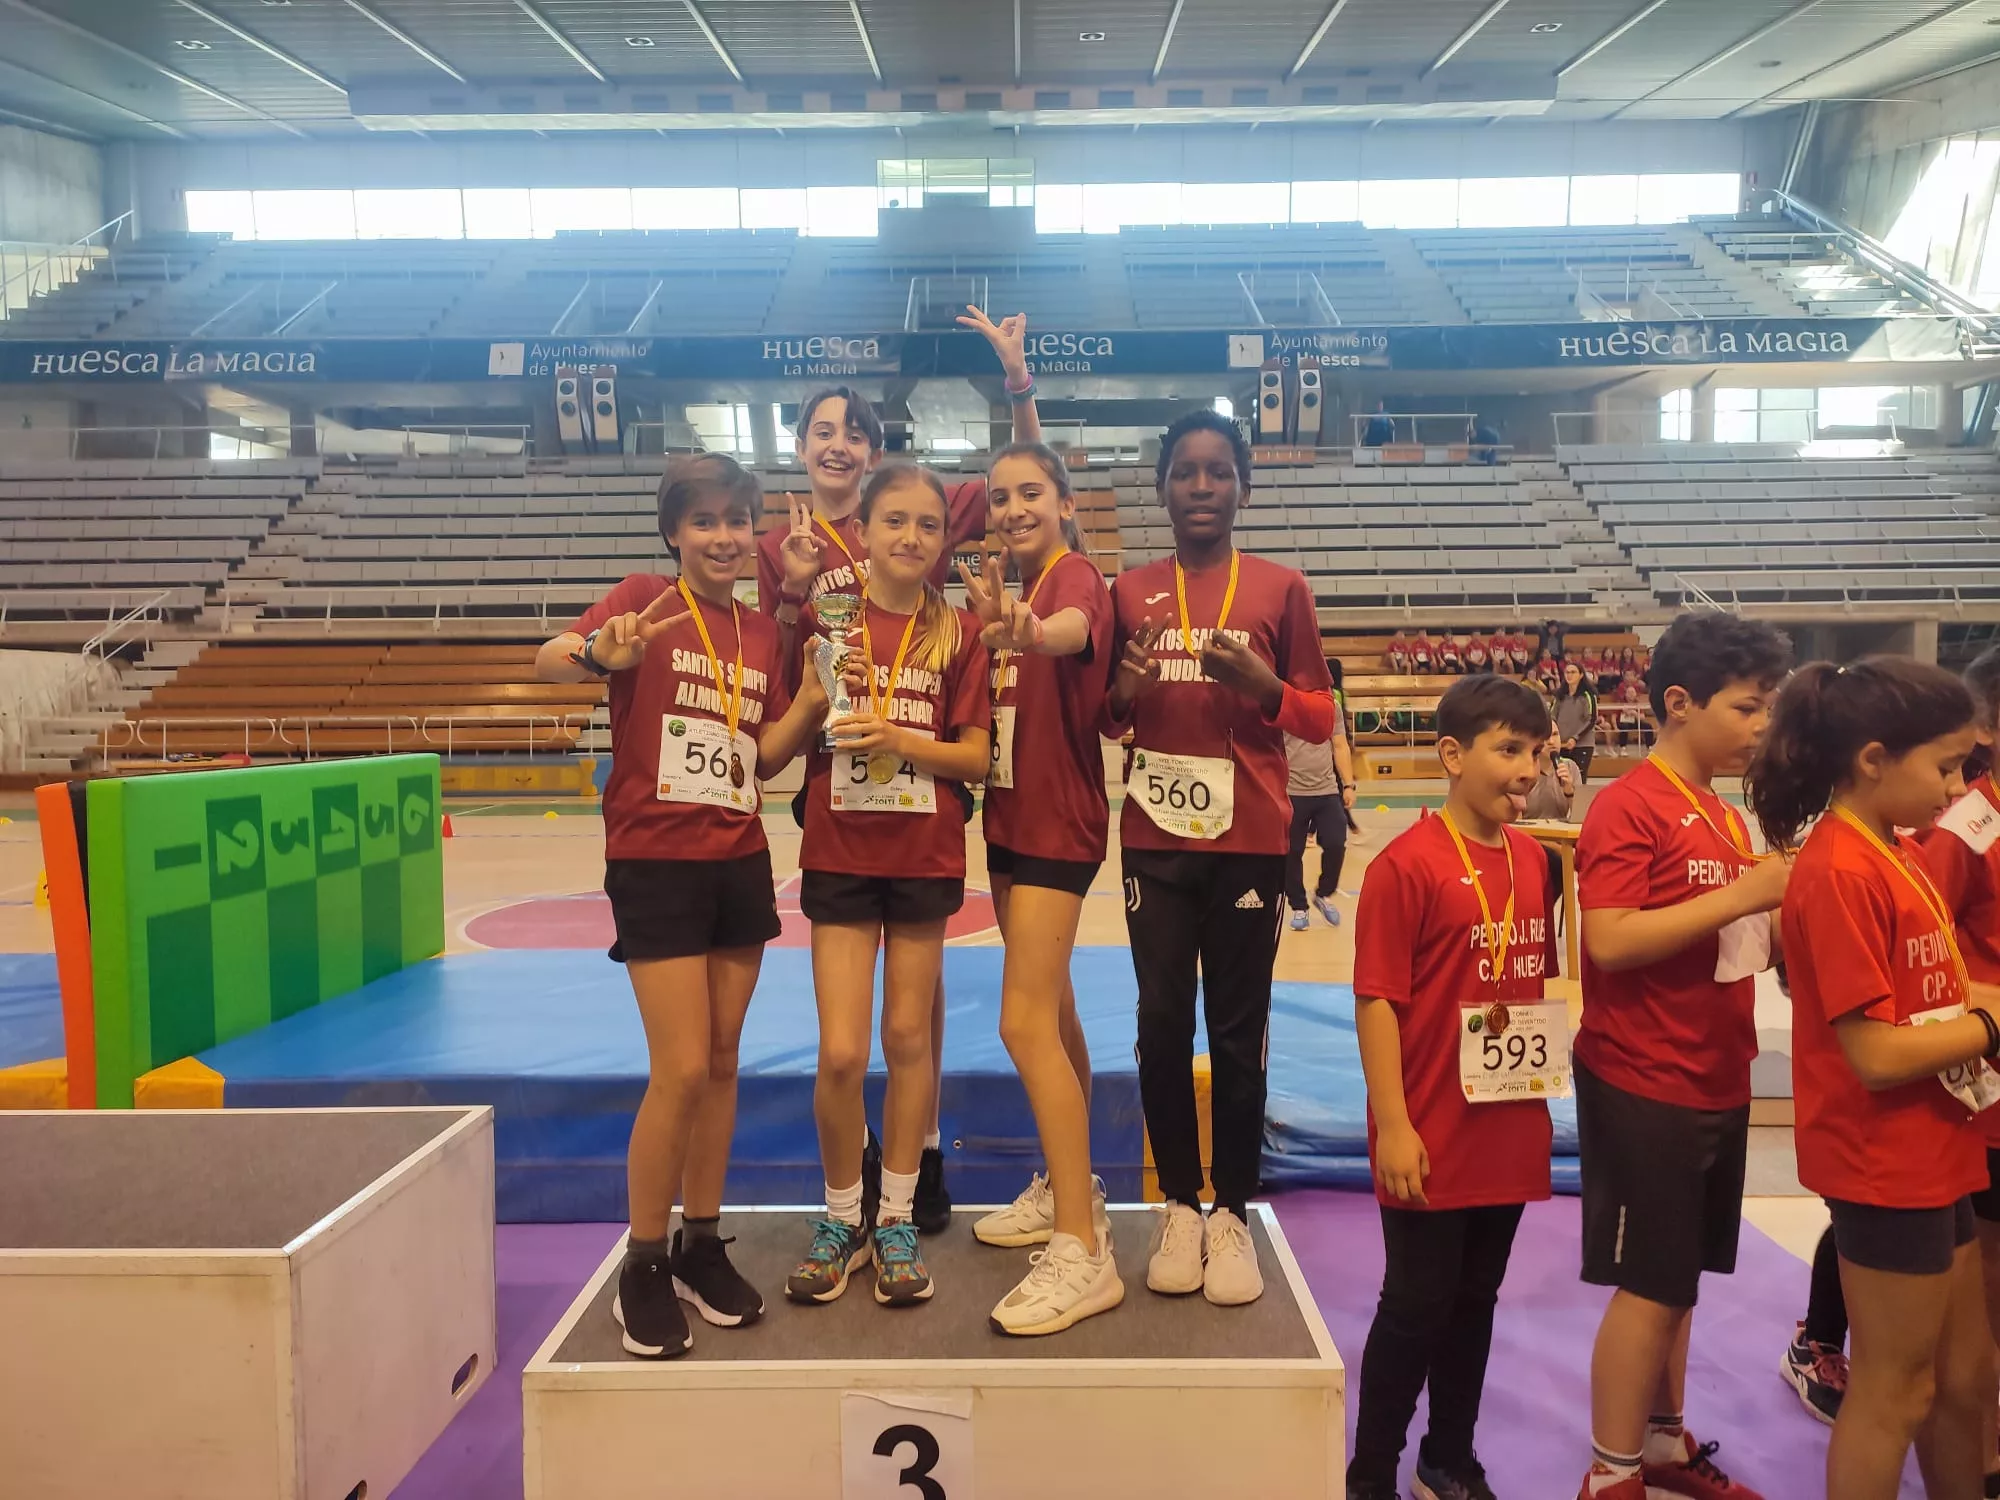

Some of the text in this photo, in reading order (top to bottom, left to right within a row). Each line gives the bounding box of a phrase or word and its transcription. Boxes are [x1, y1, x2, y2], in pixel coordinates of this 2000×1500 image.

[1271, 334, 1388, 352] Ayuntamiento
[529, 363, 548, 376] de
[684, 741, 740, 778] 56
[851, 754, 916, 785] 54
[1147, 774, 1210, 812] 560
[215, 820, 259, 876] 2
[270, 816, 310, 855] 3
[321, 806, 356, 855] 4
[364, 803, 395, 839] 5
[402, 793, 430, 836] 6
[1482, 1033, 1547, 1071] 593
[872, 1424, 947, 1500] 3
